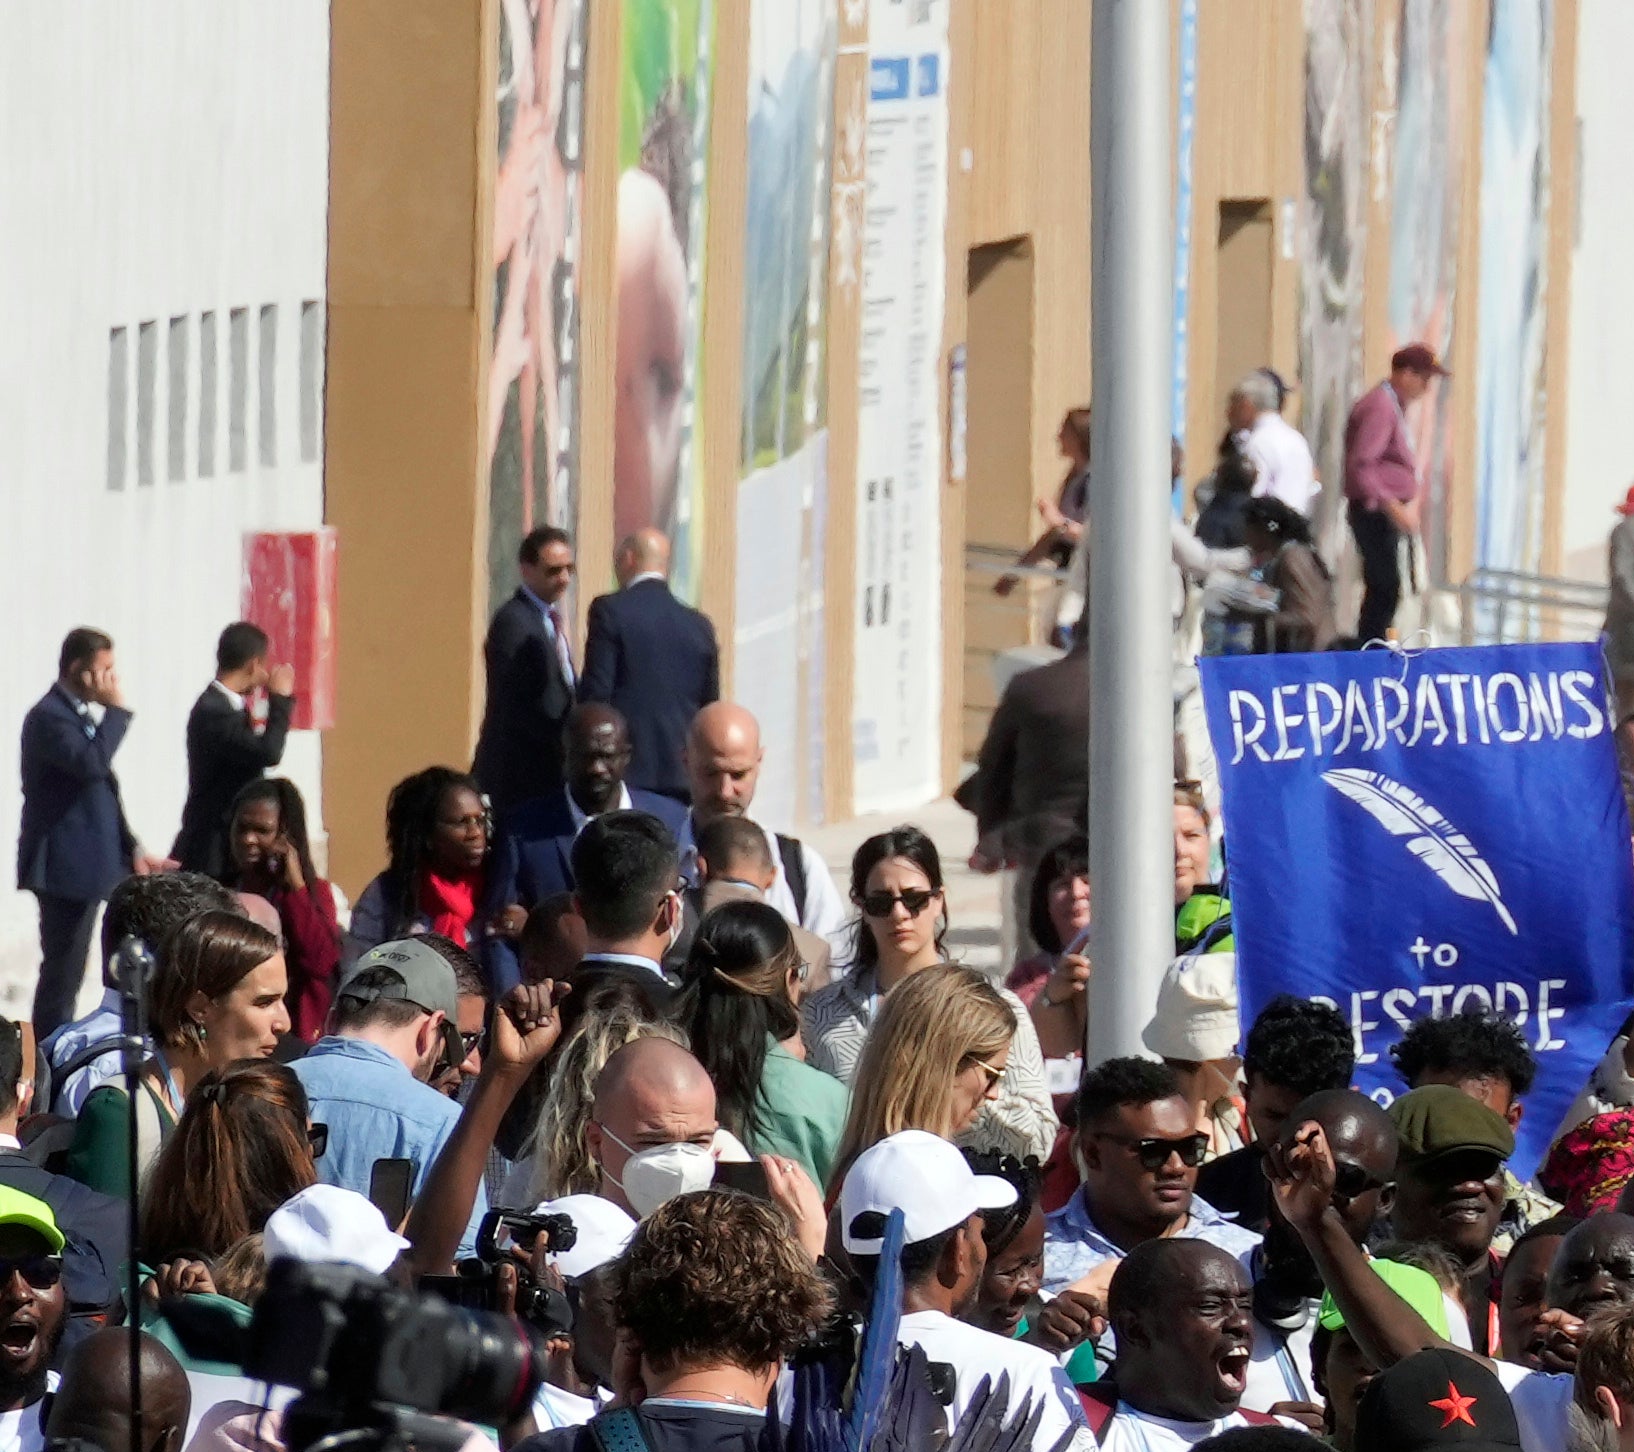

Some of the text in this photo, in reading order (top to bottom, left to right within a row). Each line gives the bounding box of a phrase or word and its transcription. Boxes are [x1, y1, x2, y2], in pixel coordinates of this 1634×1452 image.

[1229, 669, 1602, 766] REPARATIONS
[1410, 936, 1458, 968] to
[1311, 978, 1567, 1064] ESTRE
